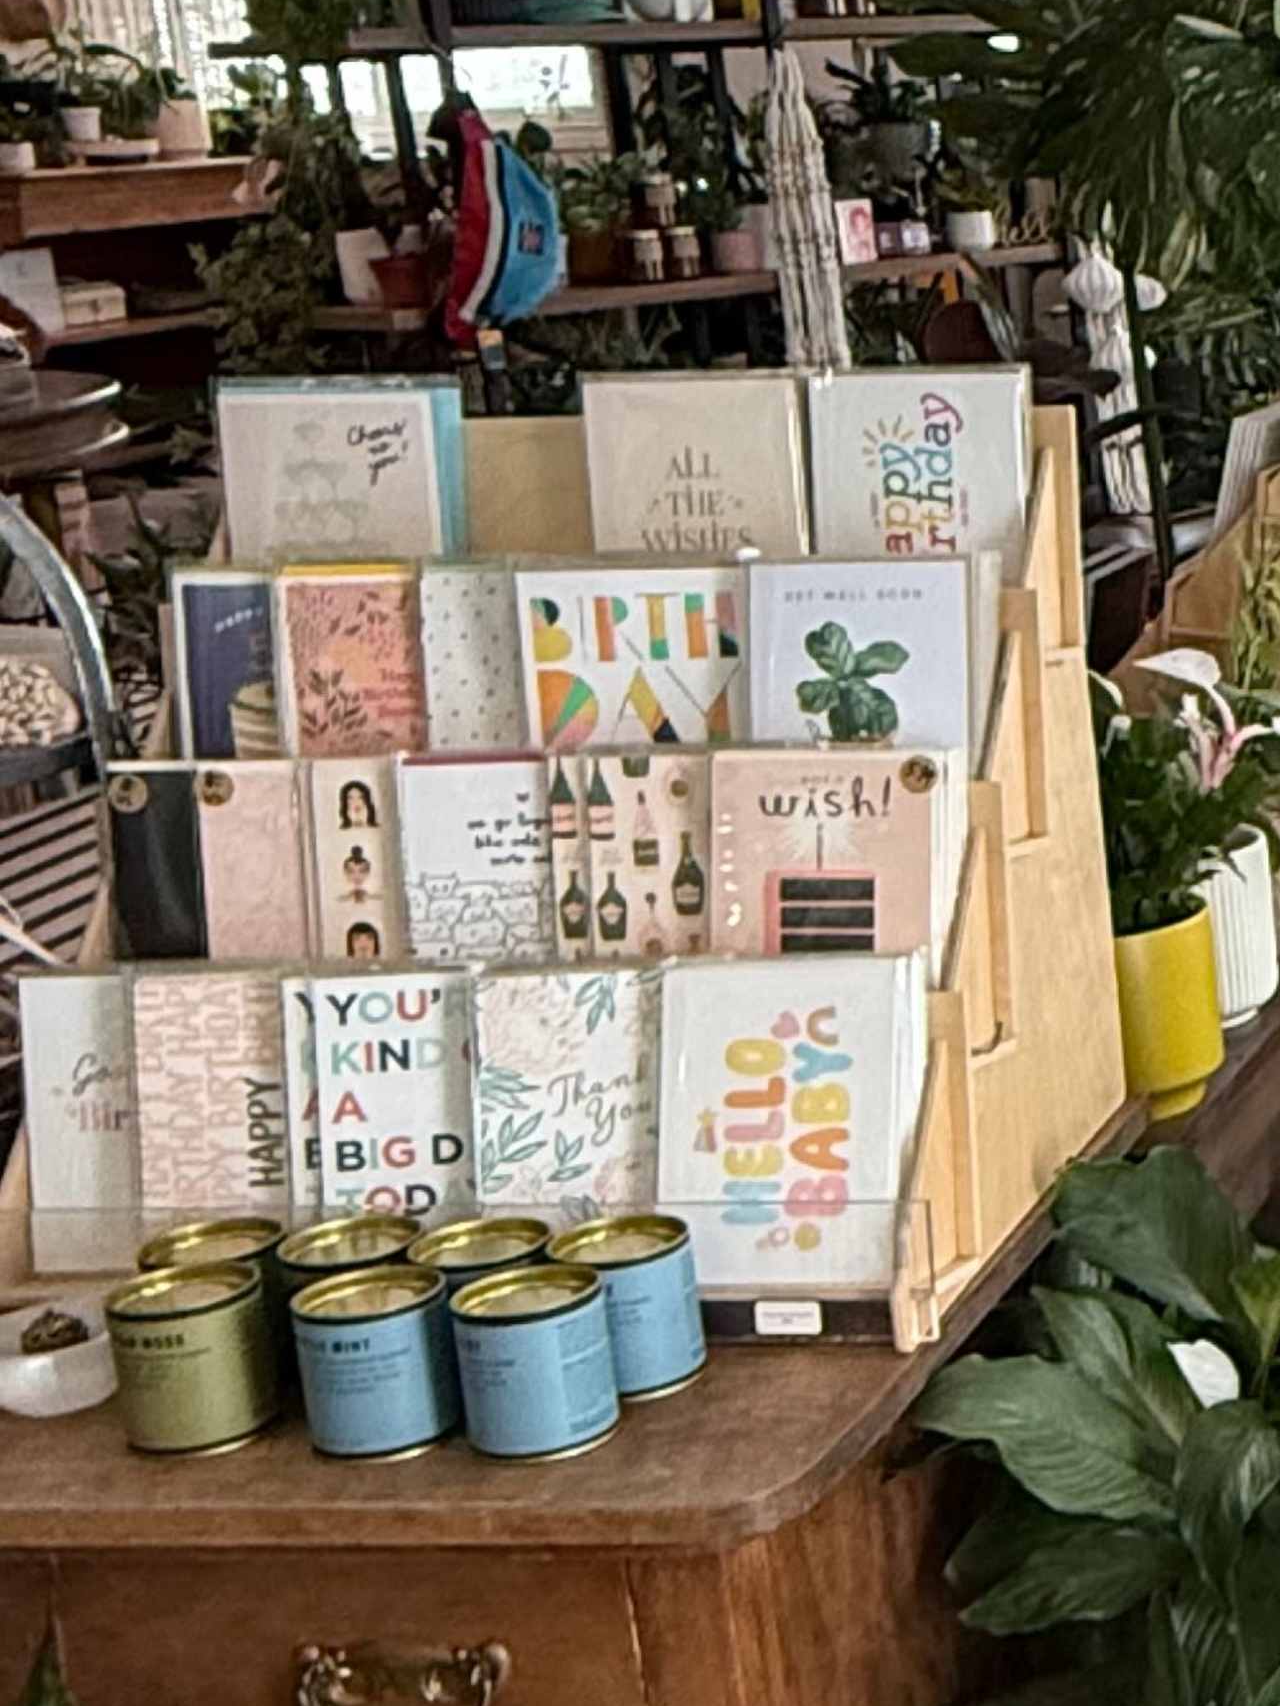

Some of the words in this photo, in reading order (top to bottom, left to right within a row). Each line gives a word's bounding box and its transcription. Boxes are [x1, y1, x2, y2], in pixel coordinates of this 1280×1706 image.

[665, 444, 721, 480] ALL
[913, 392, 964, 554] rthday
[665, 483, 725, 518] THE
[879, 441, 922, 556] appy
[529, 591, 740, 663] BIRTH
[536, 661, 742, 751] DAY
[758, 775, 892, 818] wish!
[330, 1038, 448, 1075] KIND
[241, 1077, 287, 1189] HAPPY
[331, 1090, 368, 1125] A
[584, 1095, 652, 1148] You
[720, 1037, 787, 1226] HELLO
[783, 1041, 853, 1218] BABY
[335, 1135, 416, 1173] BIG
[431, 1133, 464, 1166] D
